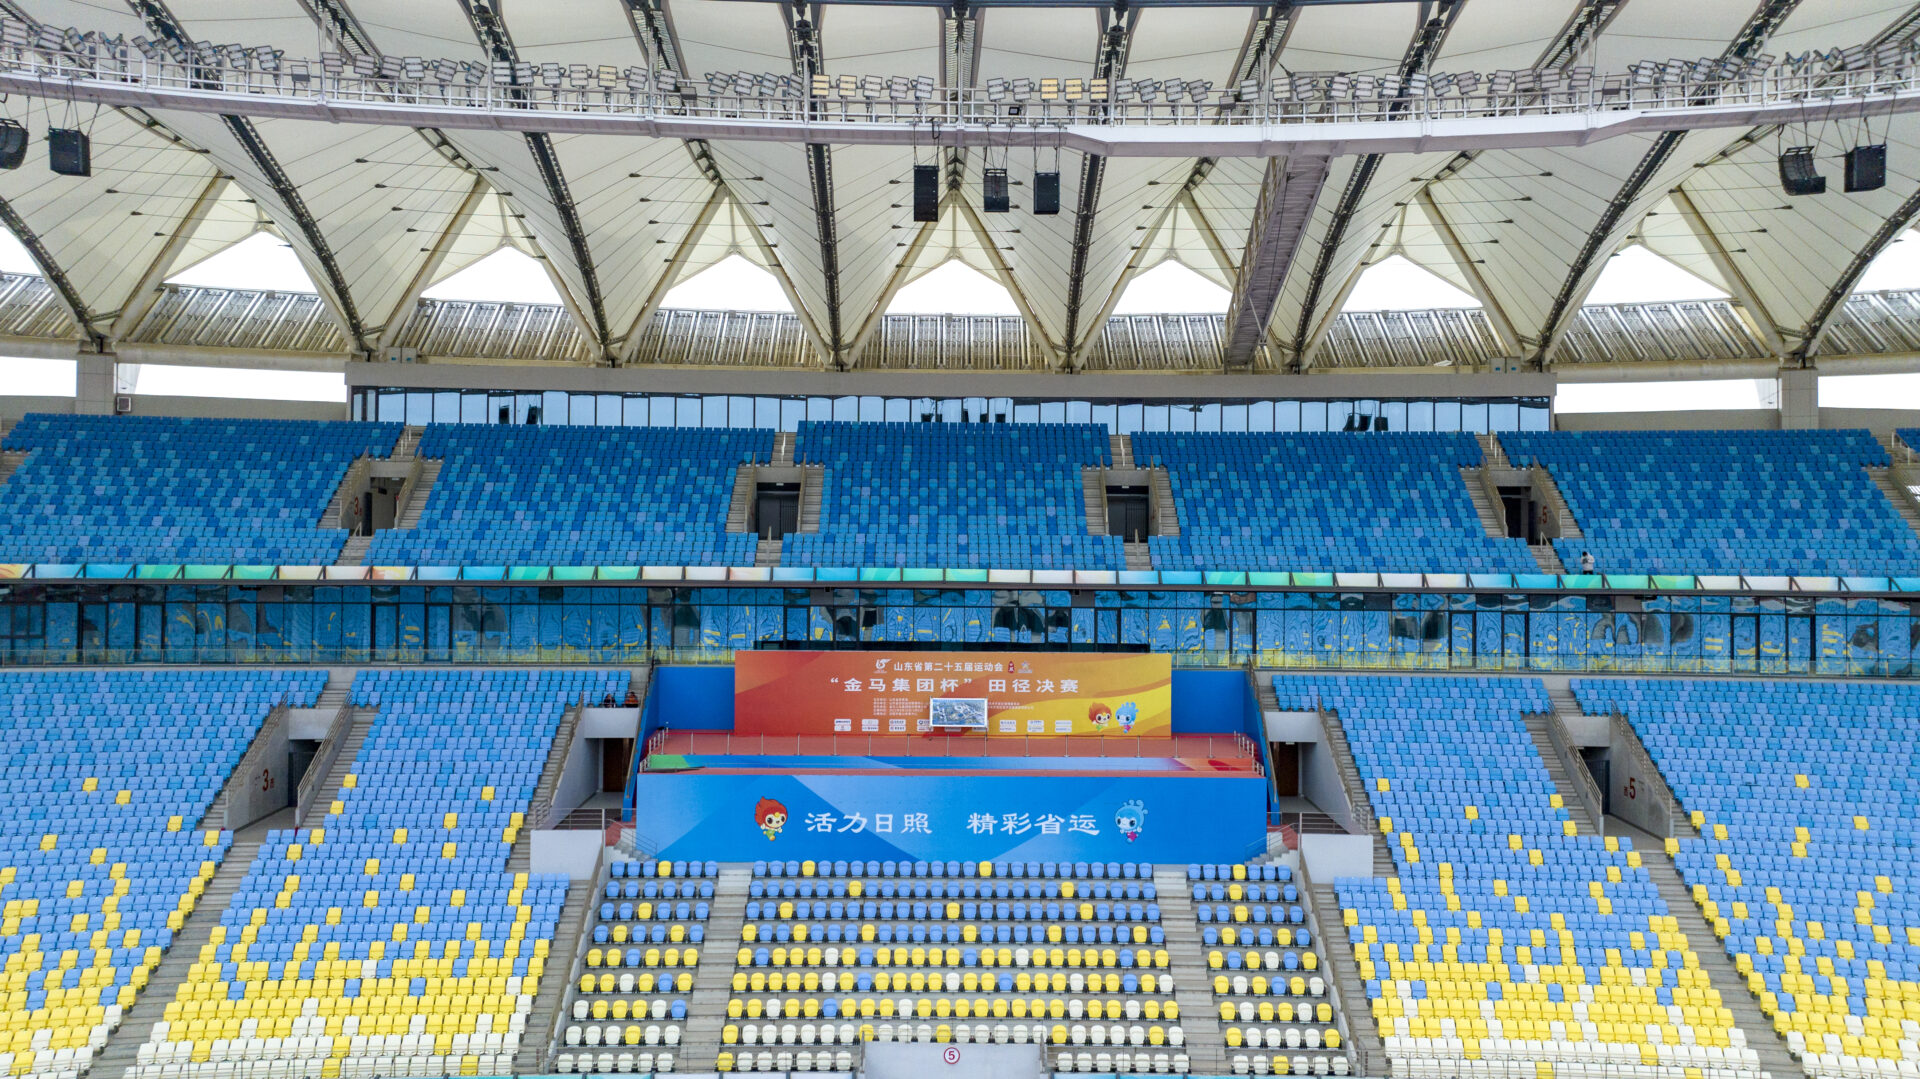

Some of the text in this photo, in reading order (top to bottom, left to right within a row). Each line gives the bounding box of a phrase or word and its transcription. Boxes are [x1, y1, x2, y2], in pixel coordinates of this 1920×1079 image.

[893, 661, 1003, 672] 山东省第二十五届运动会
[262, 768, 269, 791] 3
[1629, 776, 1636, 800] 5
[804, 811, 1101, 836] 活力日照 精彩省运
